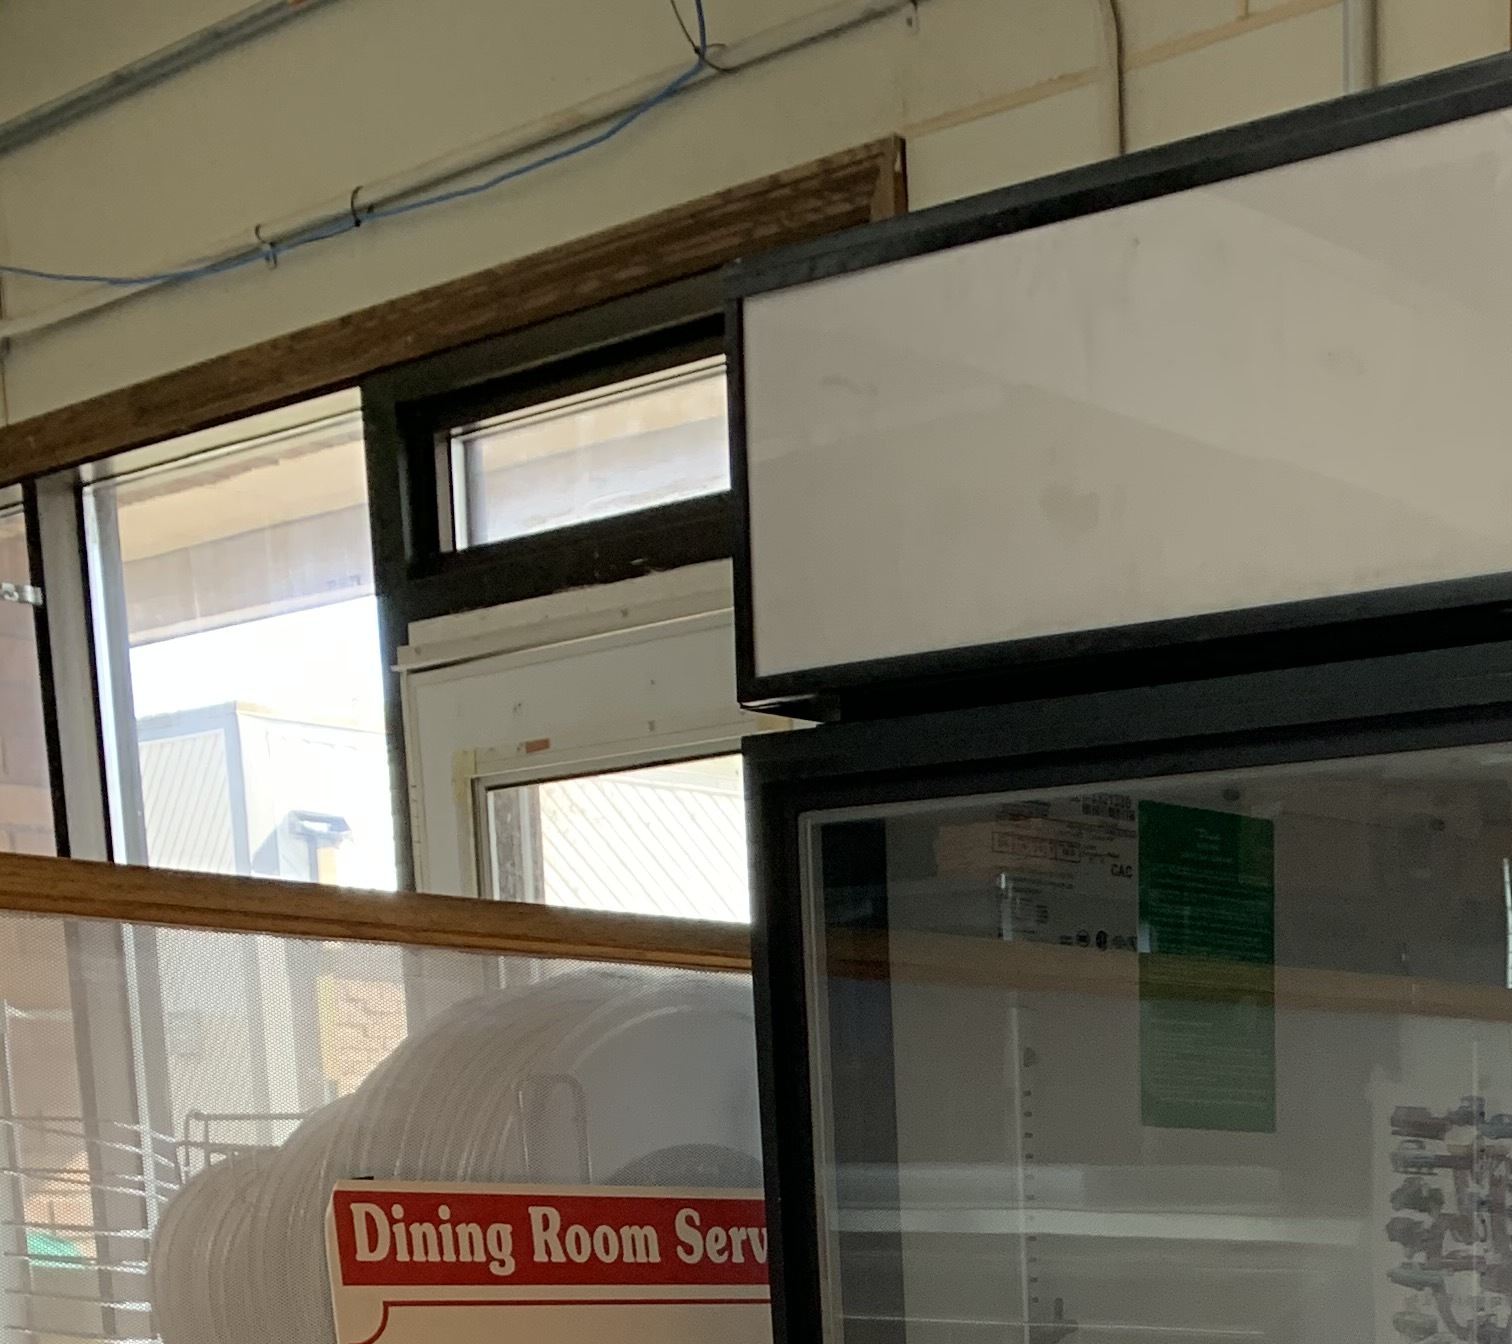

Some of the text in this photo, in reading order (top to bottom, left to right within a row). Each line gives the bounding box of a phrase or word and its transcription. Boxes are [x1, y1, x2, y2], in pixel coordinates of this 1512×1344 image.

[350, 1203, 769, 1276] Dining Room Serv
